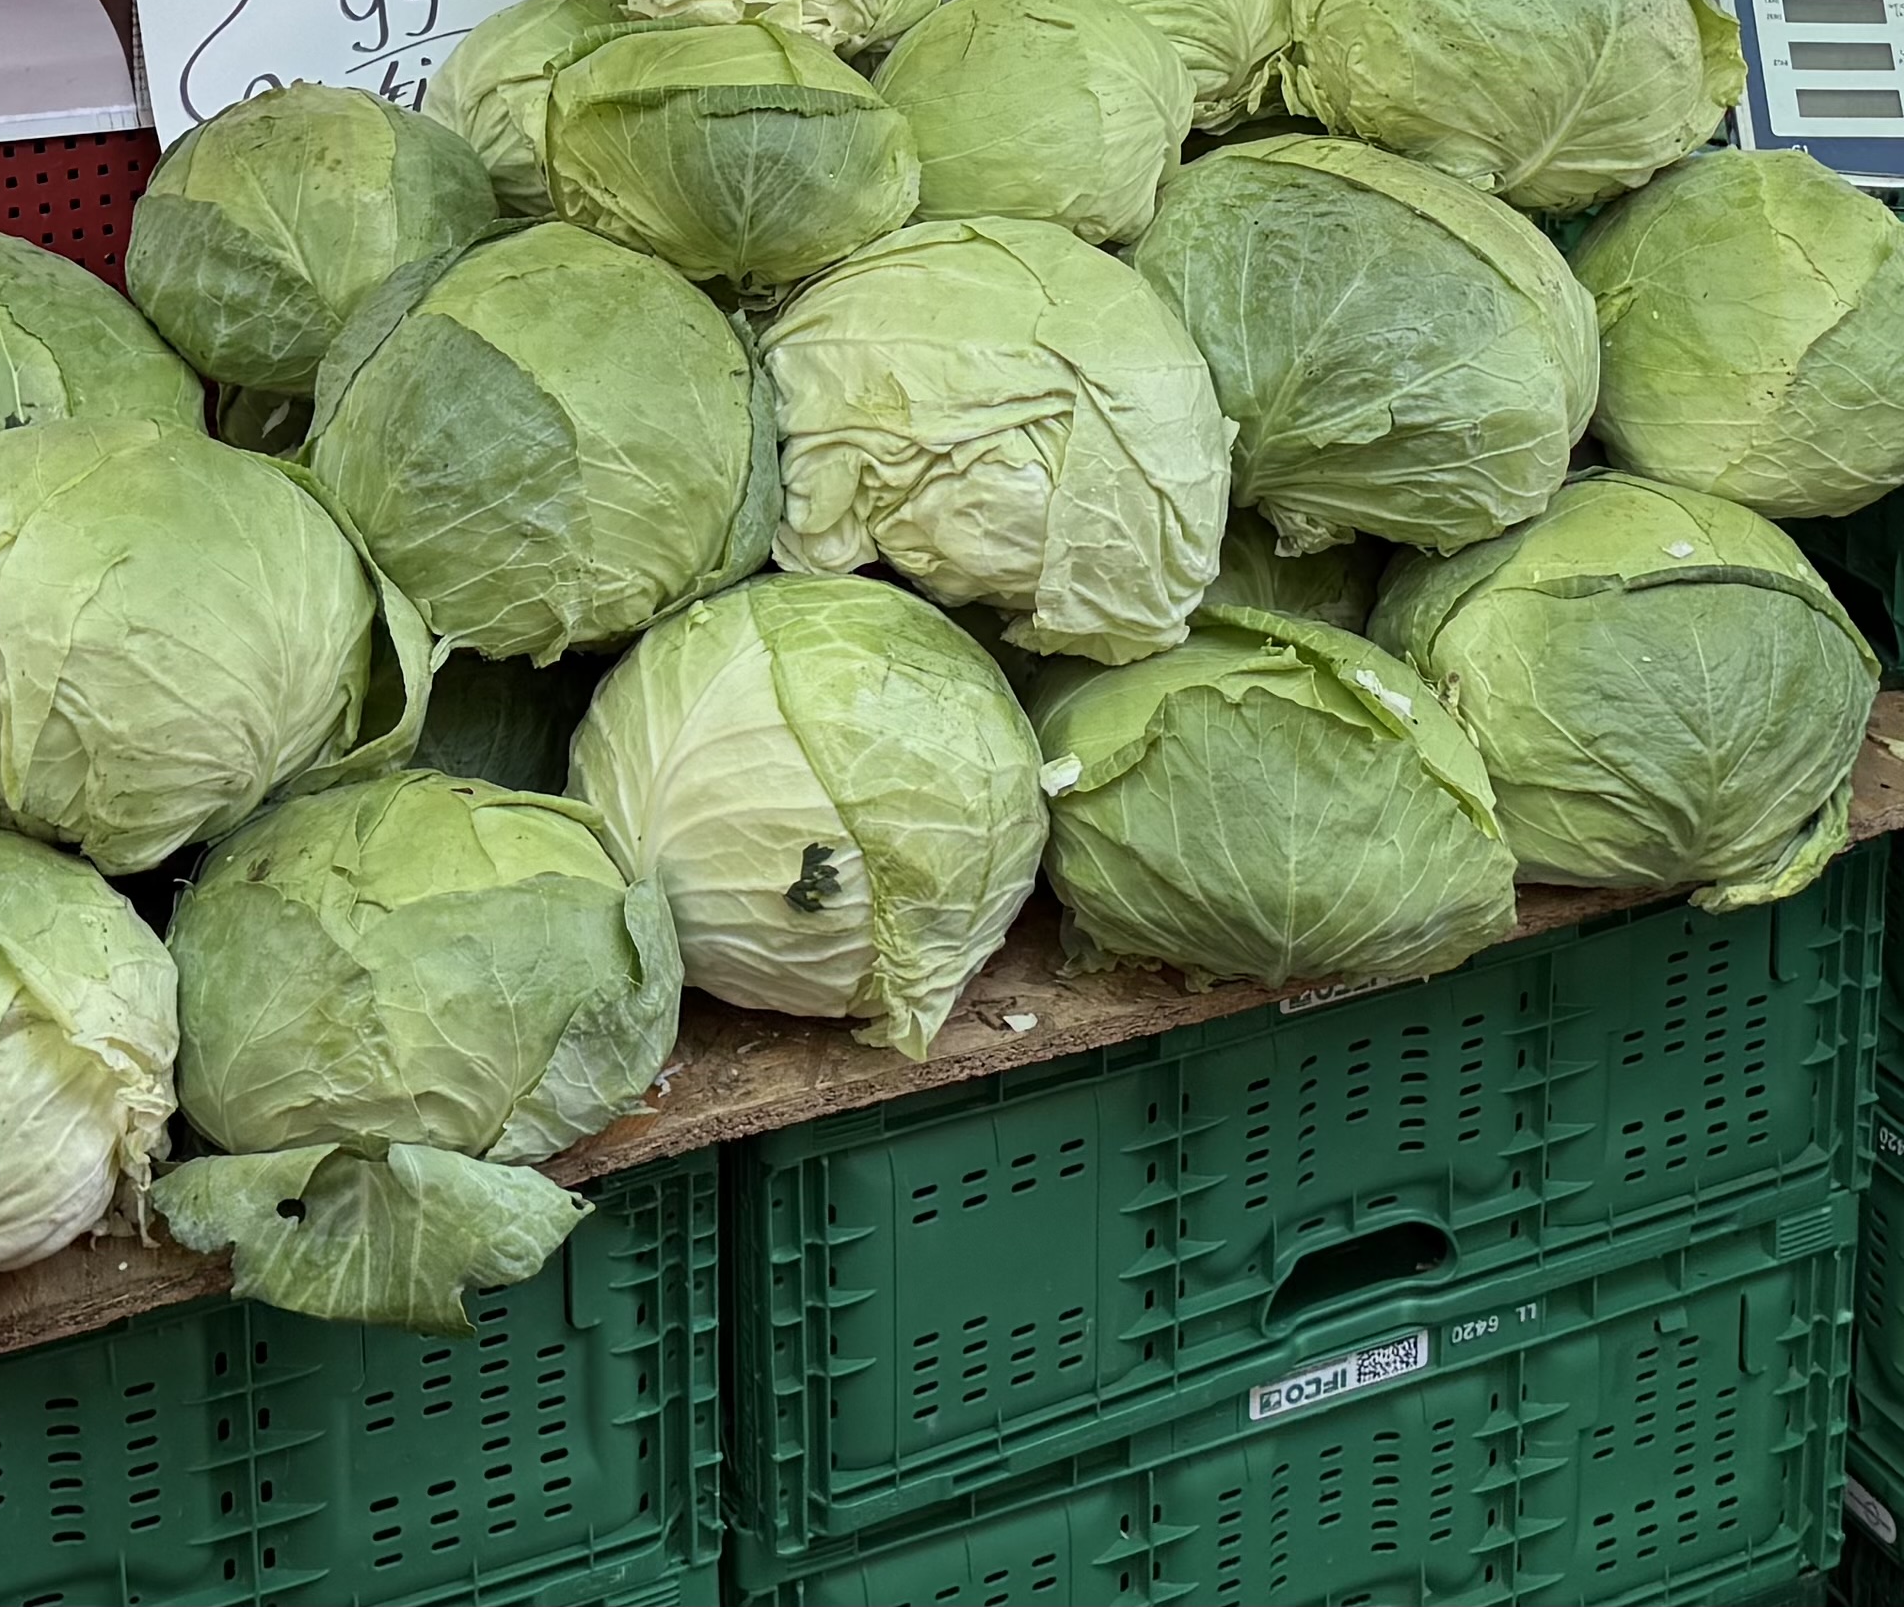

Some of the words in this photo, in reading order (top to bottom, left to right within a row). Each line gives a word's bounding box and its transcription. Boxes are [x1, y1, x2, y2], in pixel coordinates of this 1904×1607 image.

[1515, 1303, 1537, 1322] LL
[1451, 1315, 1499, 1344] 6420
[1285, 1368, 1347, 1404] IFCO
